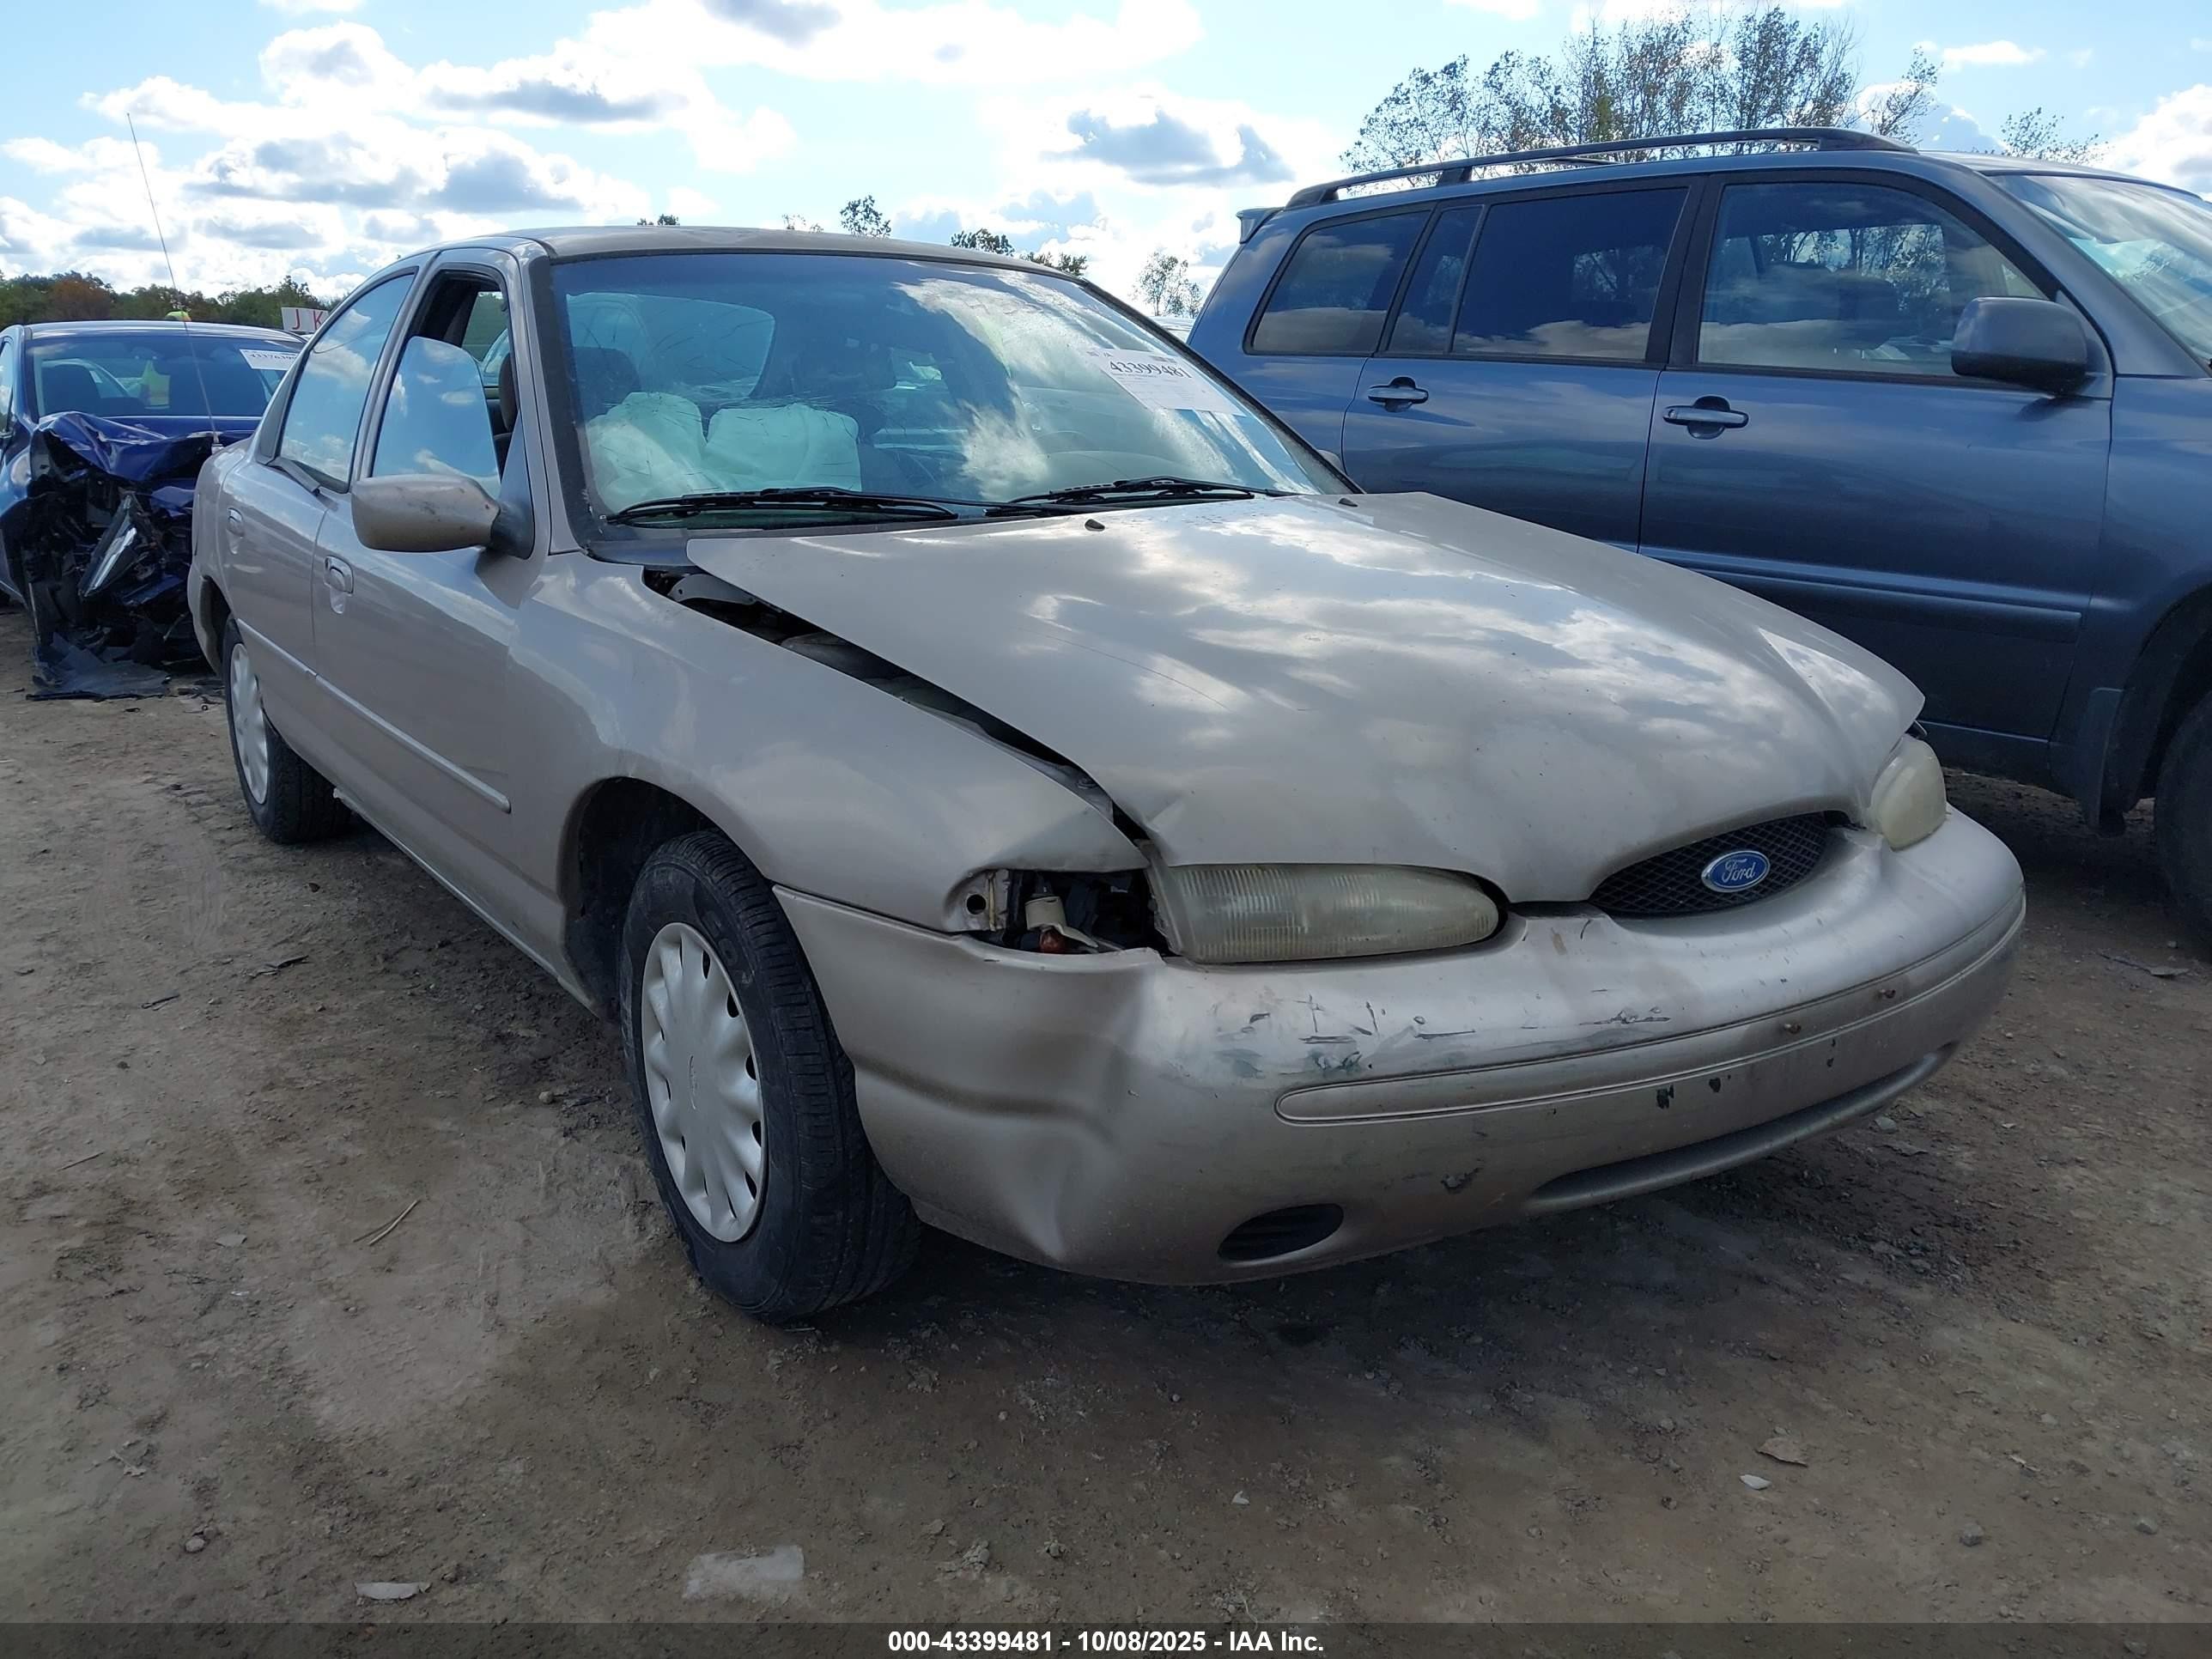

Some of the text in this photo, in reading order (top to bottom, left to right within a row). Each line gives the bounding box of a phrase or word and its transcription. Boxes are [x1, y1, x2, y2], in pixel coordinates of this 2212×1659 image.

[291, 308, 324, 331] J K
[1109, 361, 1193, 379] 43399481
[1722, 858, 1757, 884] Ford
